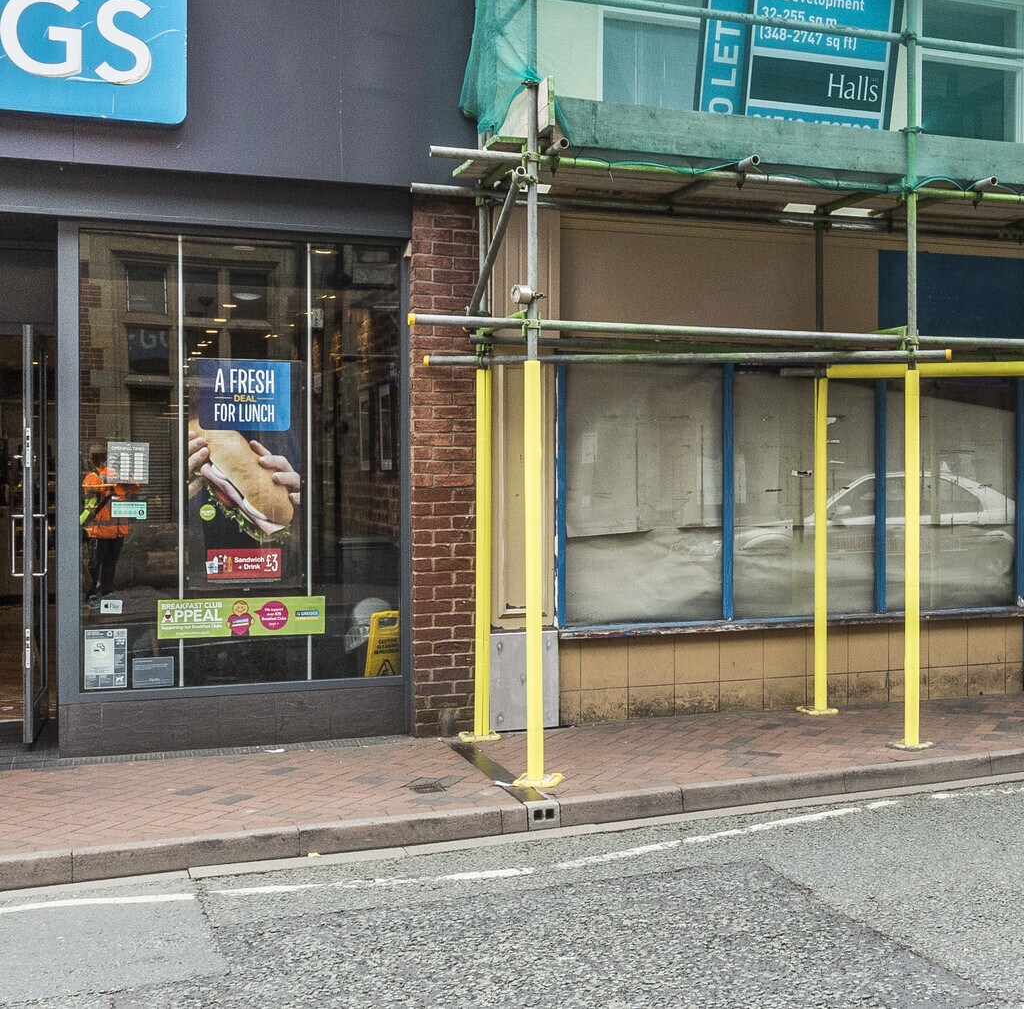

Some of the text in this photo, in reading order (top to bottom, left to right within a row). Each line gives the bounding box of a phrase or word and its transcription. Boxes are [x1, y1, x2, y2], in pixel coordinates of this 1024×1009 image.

[761, 6, 805, 22] 32-255
[825, 17, 837, 26] m
[760, 26, 857, 51] (348-2747 sq ft)
[708, 21, 741, 115] LET O
[827, 73, 878, 102] Halls
[214, 368, 275, 394] A FRESH
[233, 394, 257, 402] DEAL
[214, 403, 275, 422] FOR LUNCH
[266, 554, 278, 572] £3
[161, 601, 222, 610] BREAKFAST CLUB
[161, 609, 222, 623] APPEAL
